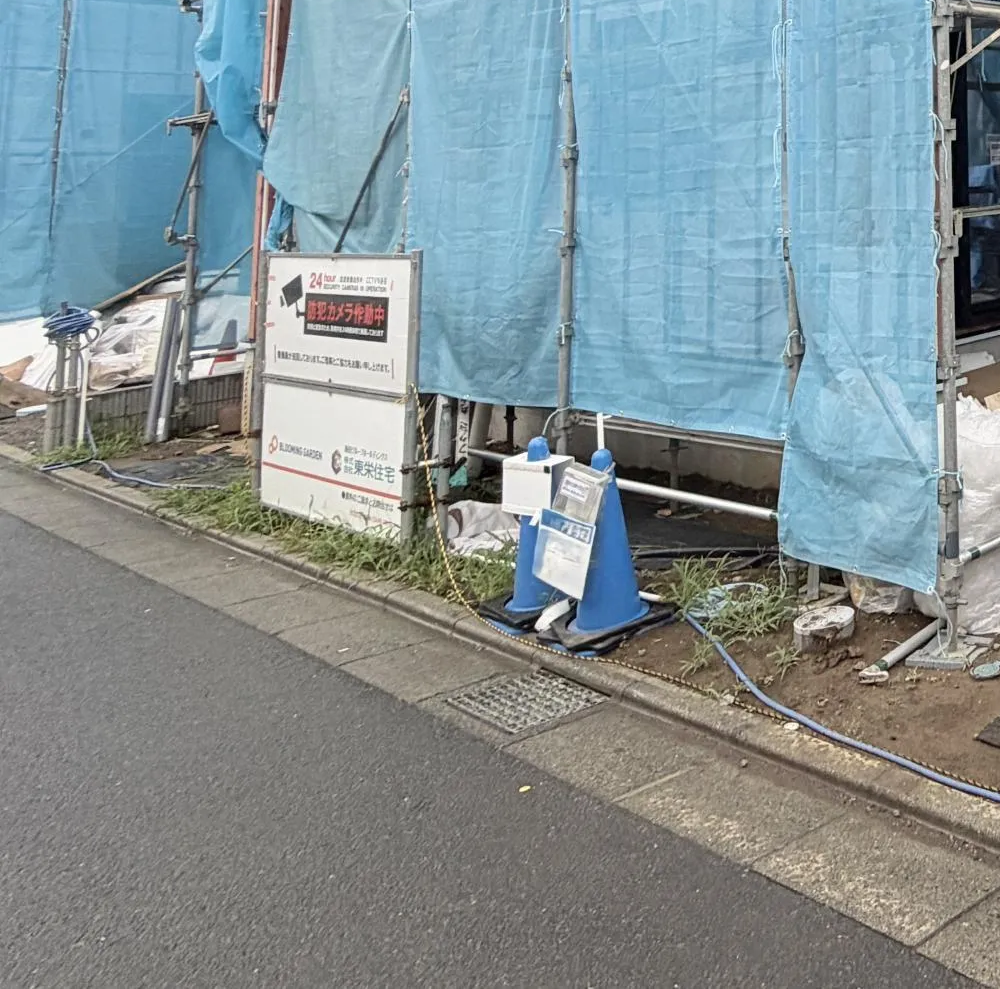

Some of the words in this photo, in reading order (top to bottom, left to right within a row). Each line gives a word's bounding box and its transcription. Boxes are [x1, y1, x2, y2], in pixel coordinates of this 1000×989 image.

[309, 272, 323, 289] 24
[307, 300, 385, 326] 防犯カメラ作動中
[354, 459, 396, 484] 東栄住宅
